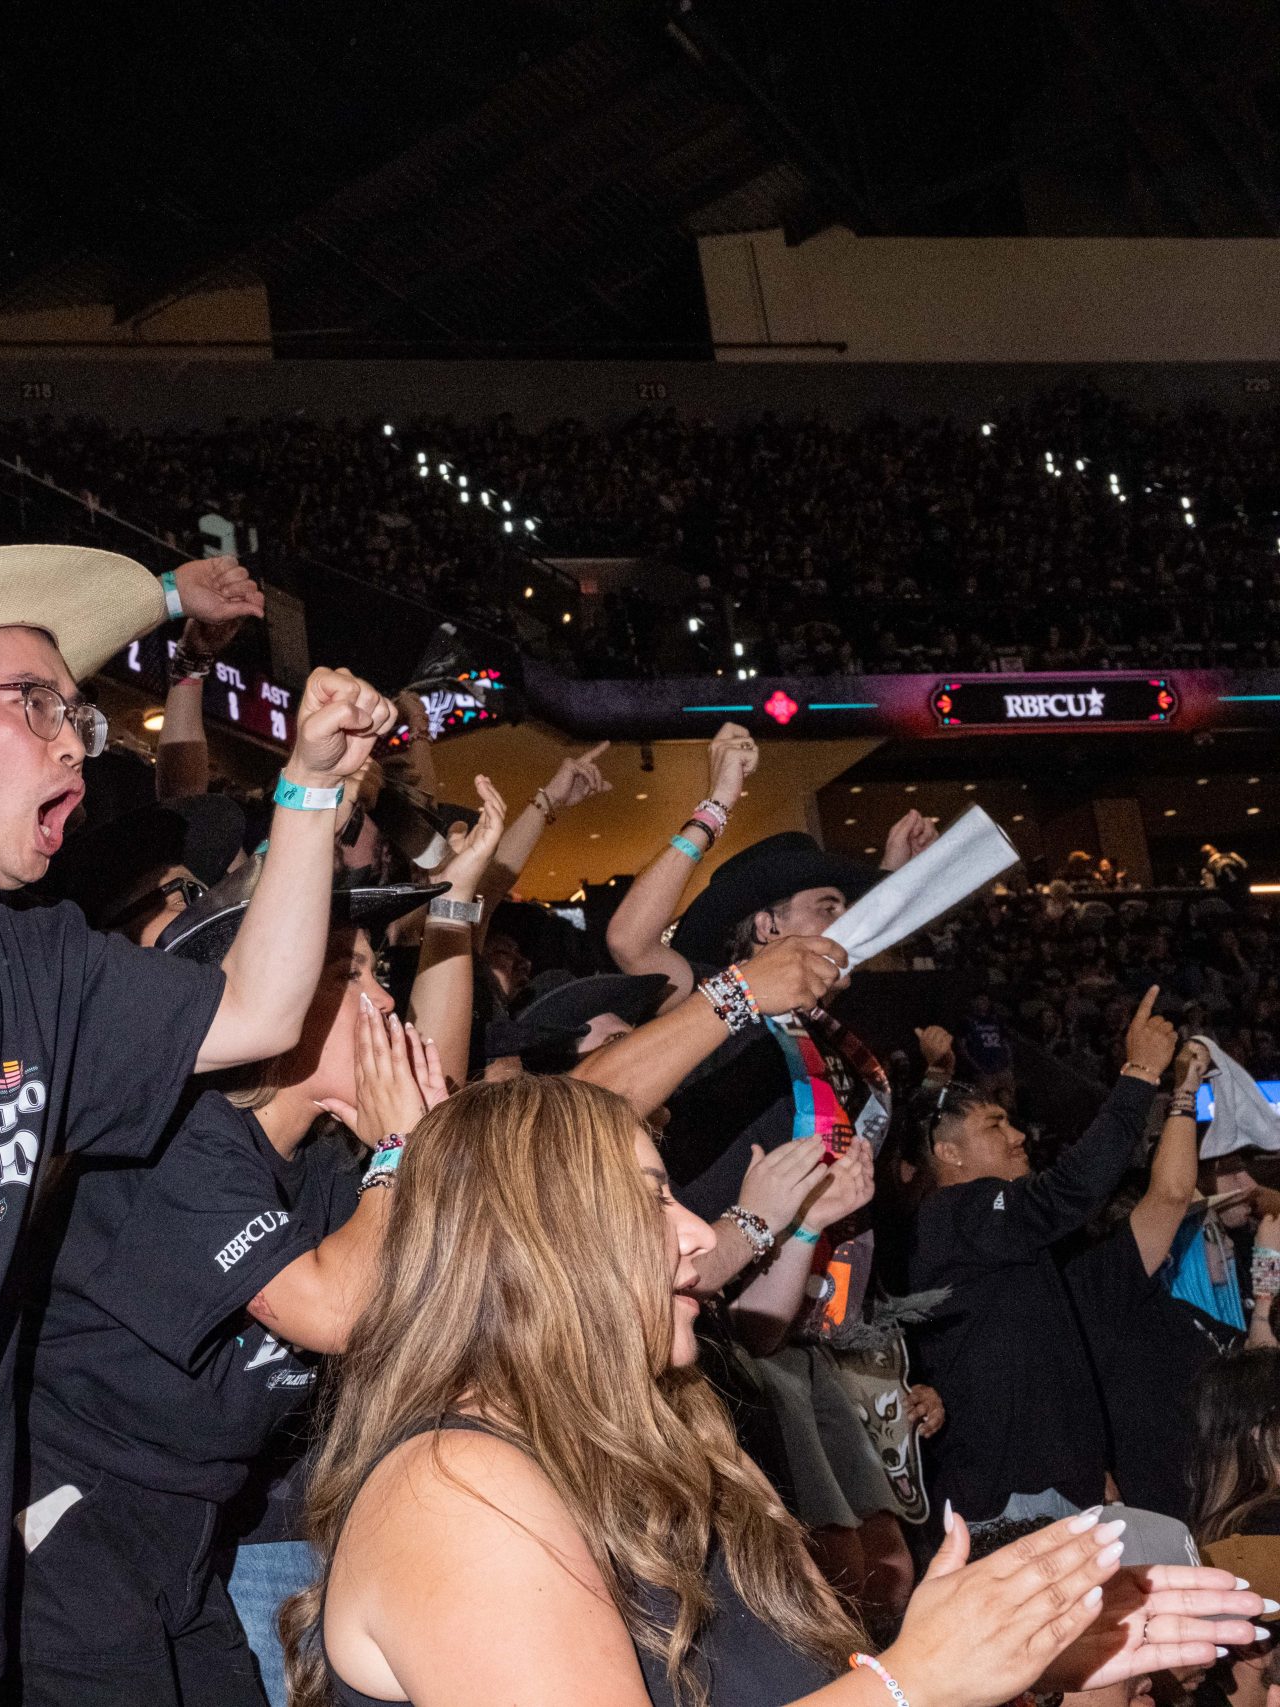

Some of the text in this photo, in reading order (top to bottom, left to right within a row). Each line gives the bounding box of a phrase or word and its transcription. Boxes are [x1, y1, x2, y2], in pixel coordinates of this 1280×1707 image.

[215, 661, 291, 709] STL AST
[1003, 693, 1087, 718] RBFCU
[214, 1211, 278, 1273] RBFCU
